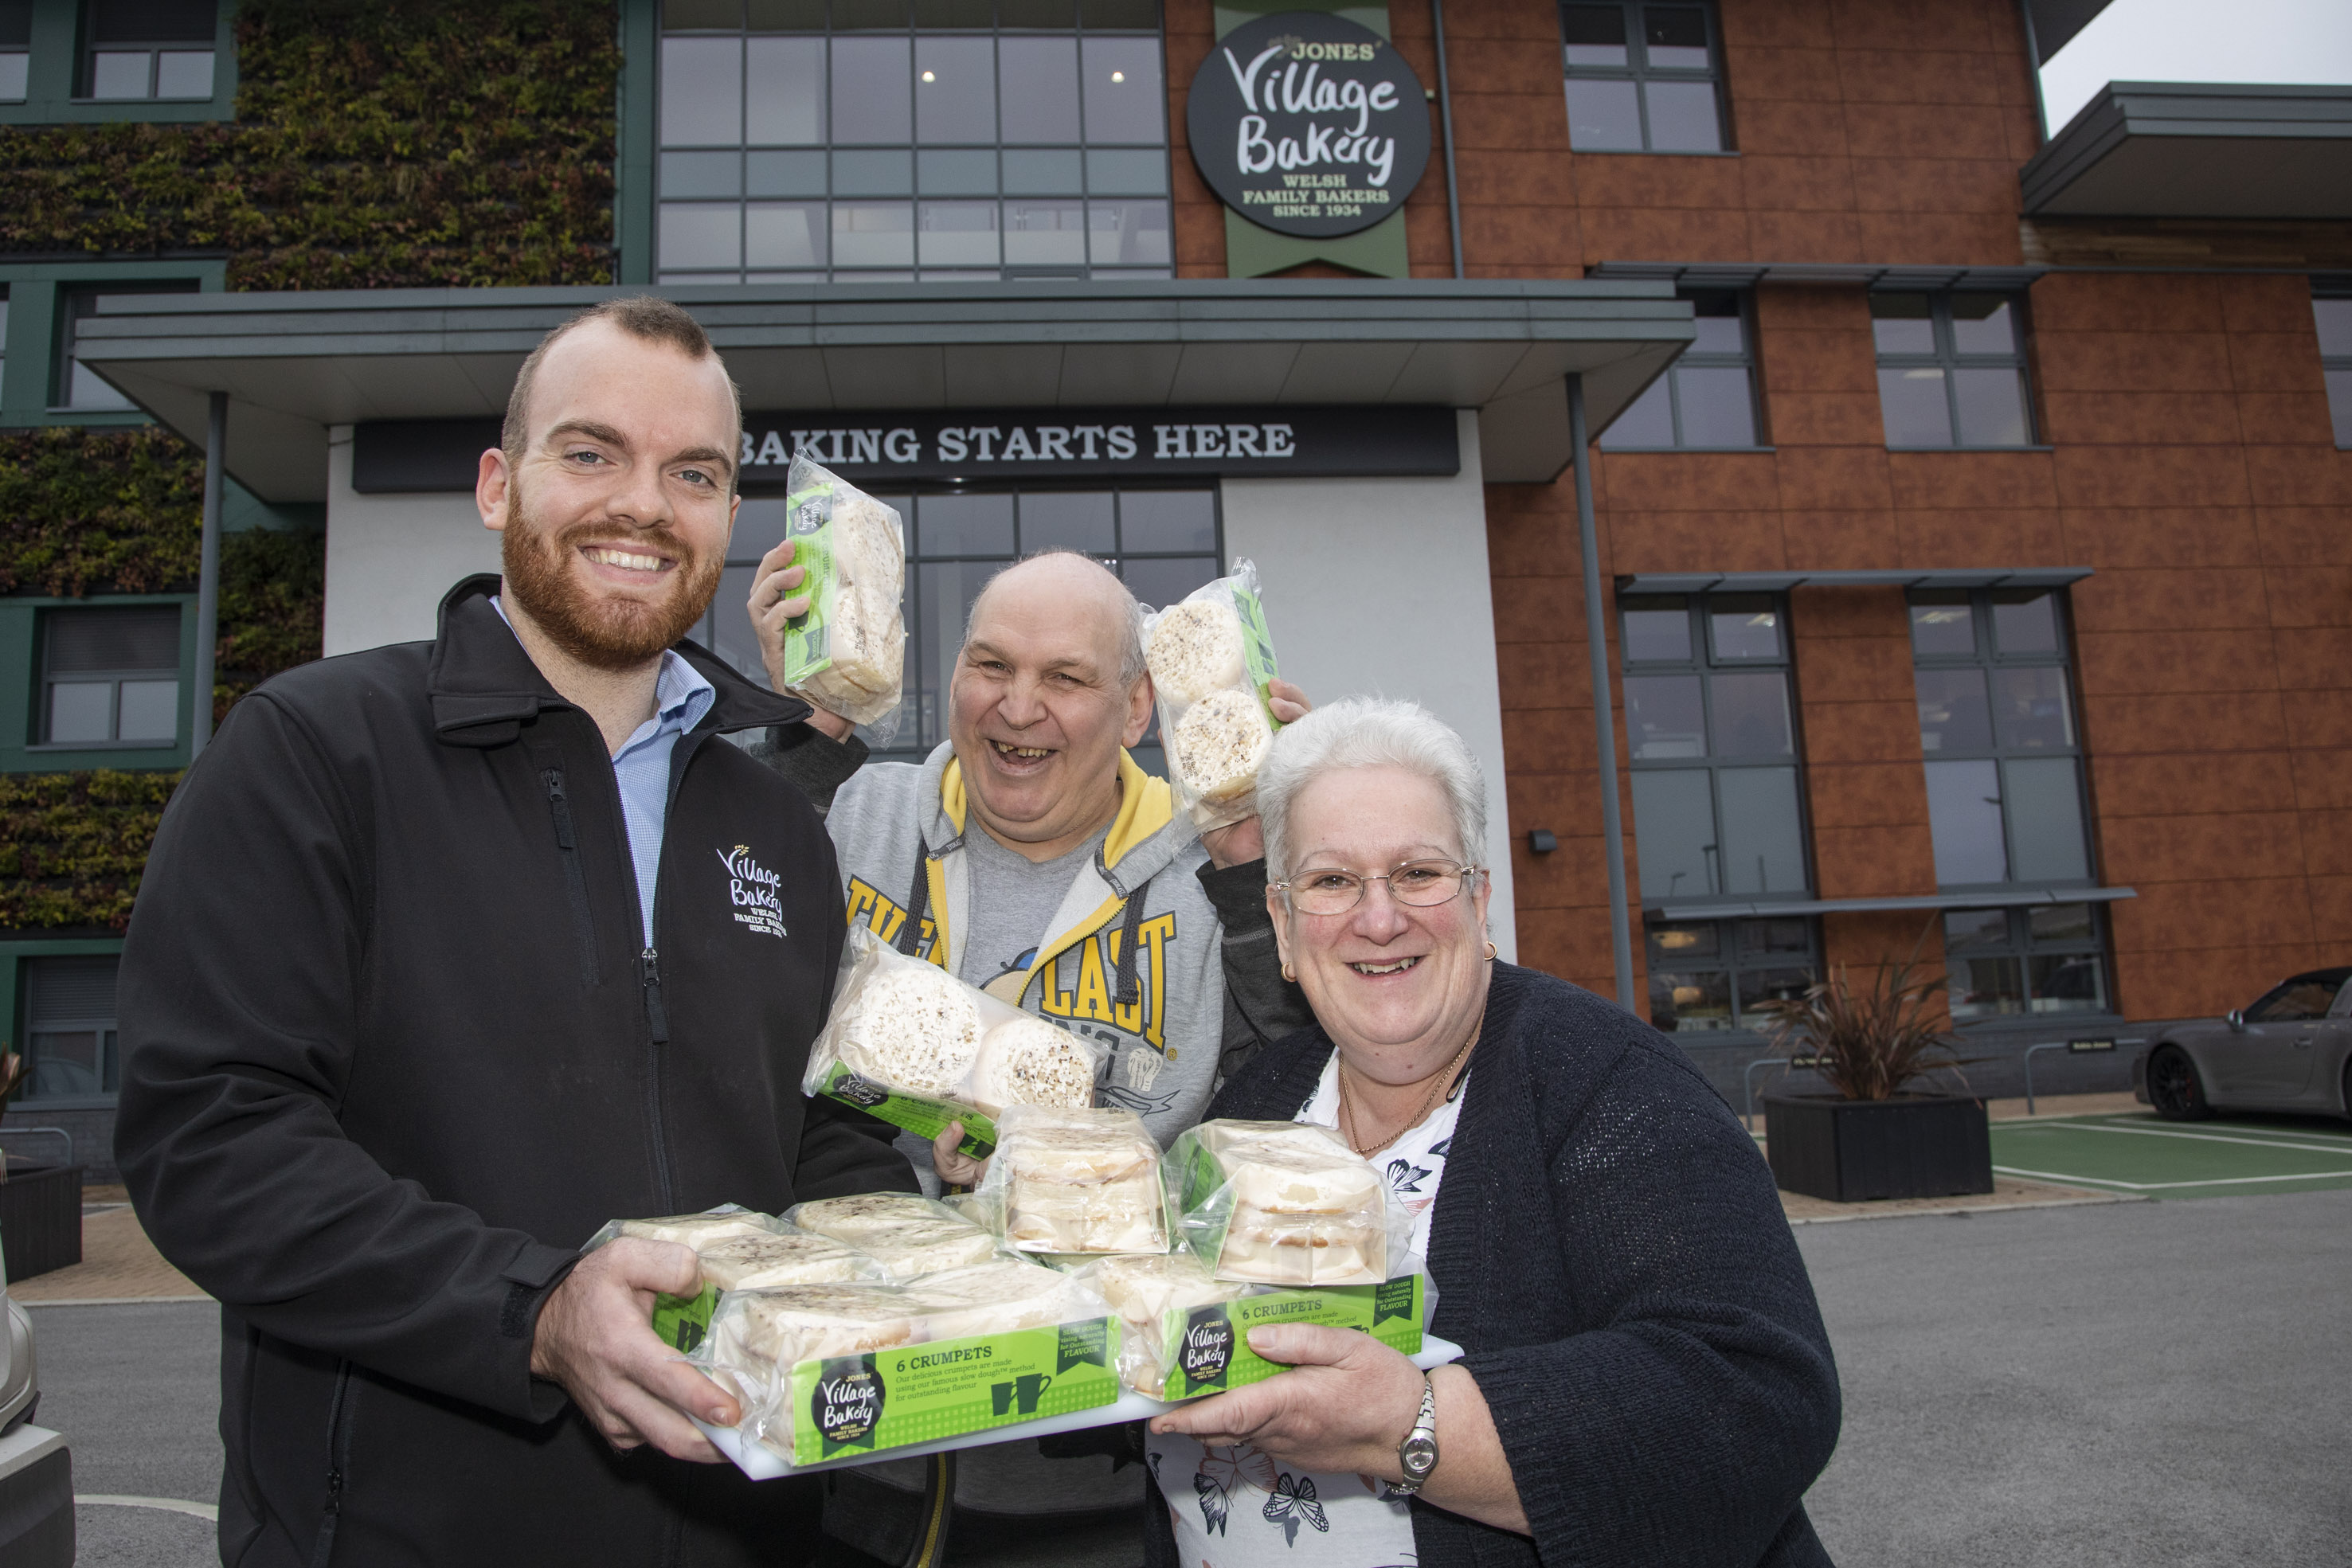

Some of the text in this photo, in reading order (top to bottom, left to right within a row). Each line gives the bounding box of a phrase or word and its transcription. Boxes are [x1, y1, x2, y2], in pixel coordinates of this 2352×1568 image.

[1223, 45, 1399, 137] Village
[1237, 115, 1394, 186] Bakery
[1282, 174, 1347, 188] WELSH
[1243, 189, 1390, 204] FAMILY BAKERS
[1273, 204, 1362, 217] SINCE 1934
[937, 425, 1138, 462] STARTS
[1153, 424, 1296, 459] HERE
[716, 848, 781, 897] Village
[730, 878, 783, 922] Bakery
[734, 913, 765, 925] FAMILY
[749, 924, 771, 933] SINCE
[1243, 1300, 1322, 1320] 6 CRUMPETS
[1380, 1300, 1407, 1312] FLAVOUR
[1336, 1316, 1356, 1324] method
[1186, 1324, 1227, 1352] Village
[897, 1346, 992, 1372] 6 CRUMPETS
[1064, 1345, 1100, 1358] FLAVOUR
[1188, 1348, 1225, 1369] Bakery
[912, 1371, 942, 1380] delicious
[944, 1364, 977, 1374] crumpets
[992, 1358, 1012, 1367] made
[932, 1377, 958, 1386] famous
[1009, 1363, 1035, 1373] method
[821, 1378, 876, 1409] Village
[907, 1386, 951, 1399] outstanding
[952, 1382, 976, 1392] flavour
[824, 1405, 873, 1428] Bakery
